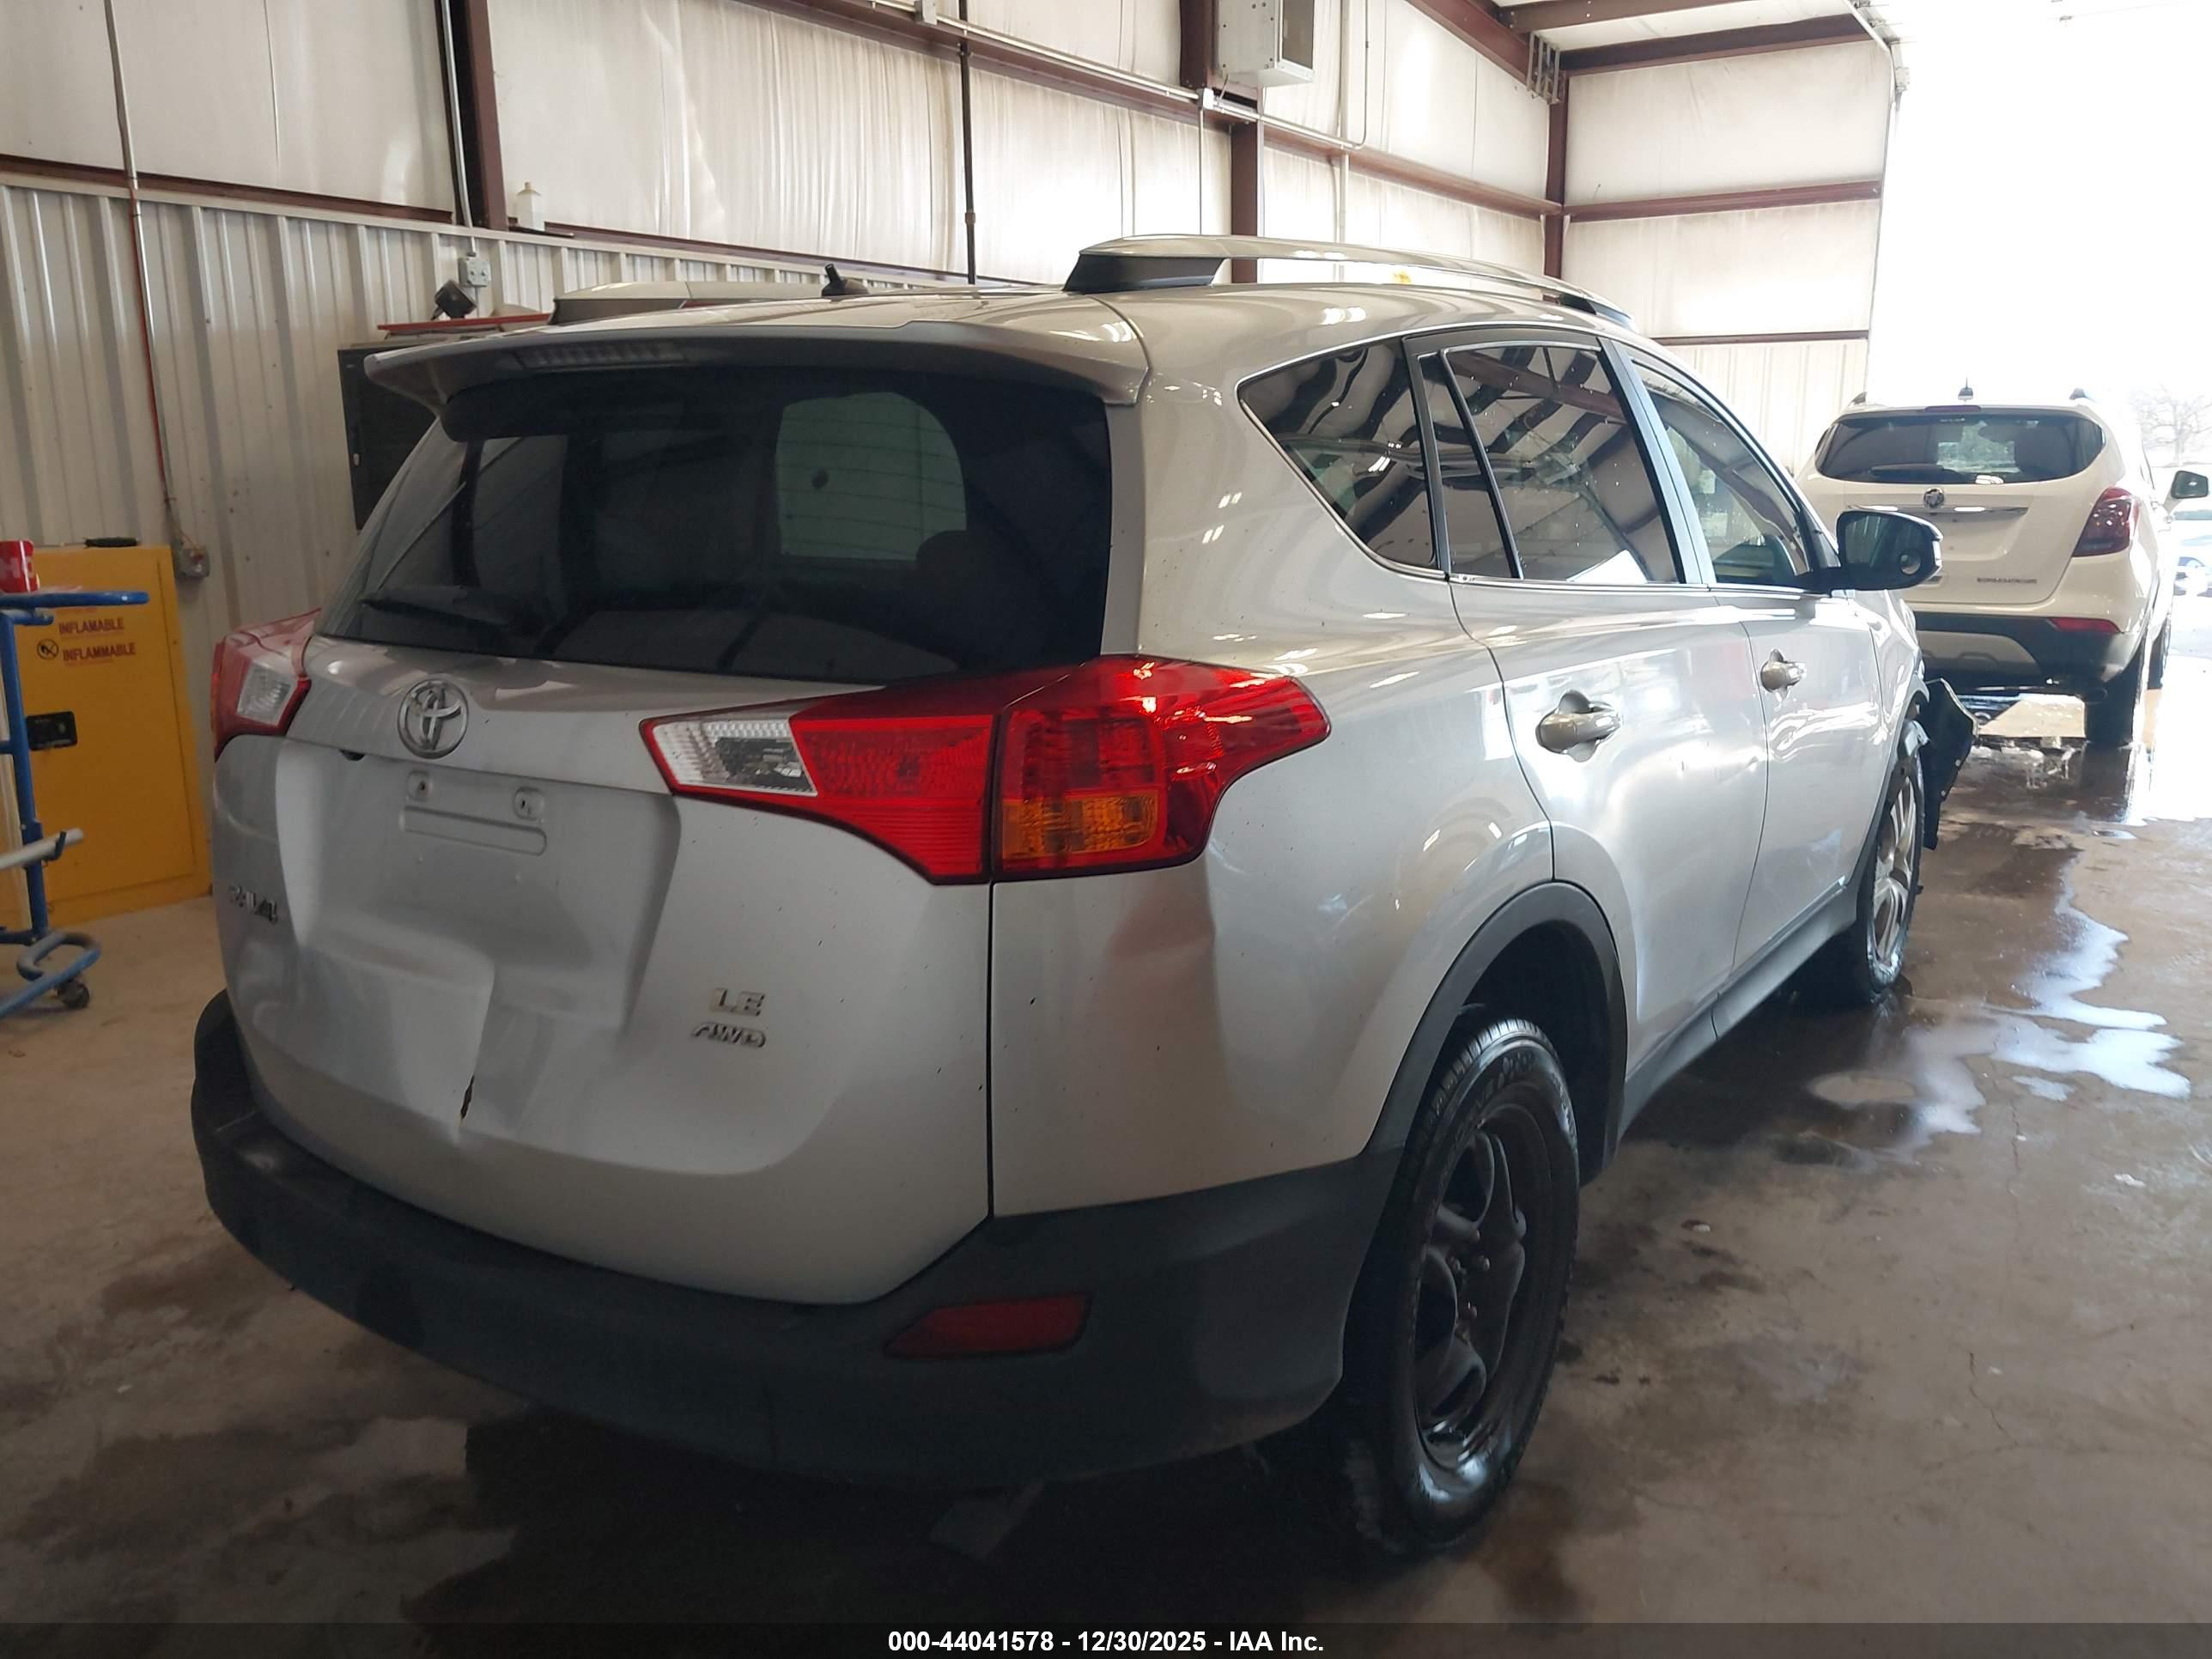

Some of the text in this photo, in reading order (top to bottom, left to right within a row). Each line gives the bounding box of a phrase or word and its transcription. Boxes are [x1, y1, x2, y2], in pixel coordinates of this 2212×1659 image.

[58, 617, 125, 634] INFLAMABLE
[63, 642, 137, 661] INFLAMMABLE
[710, 988, 765, 1016] LE
[690, 1022, 766, 1048] AWD
